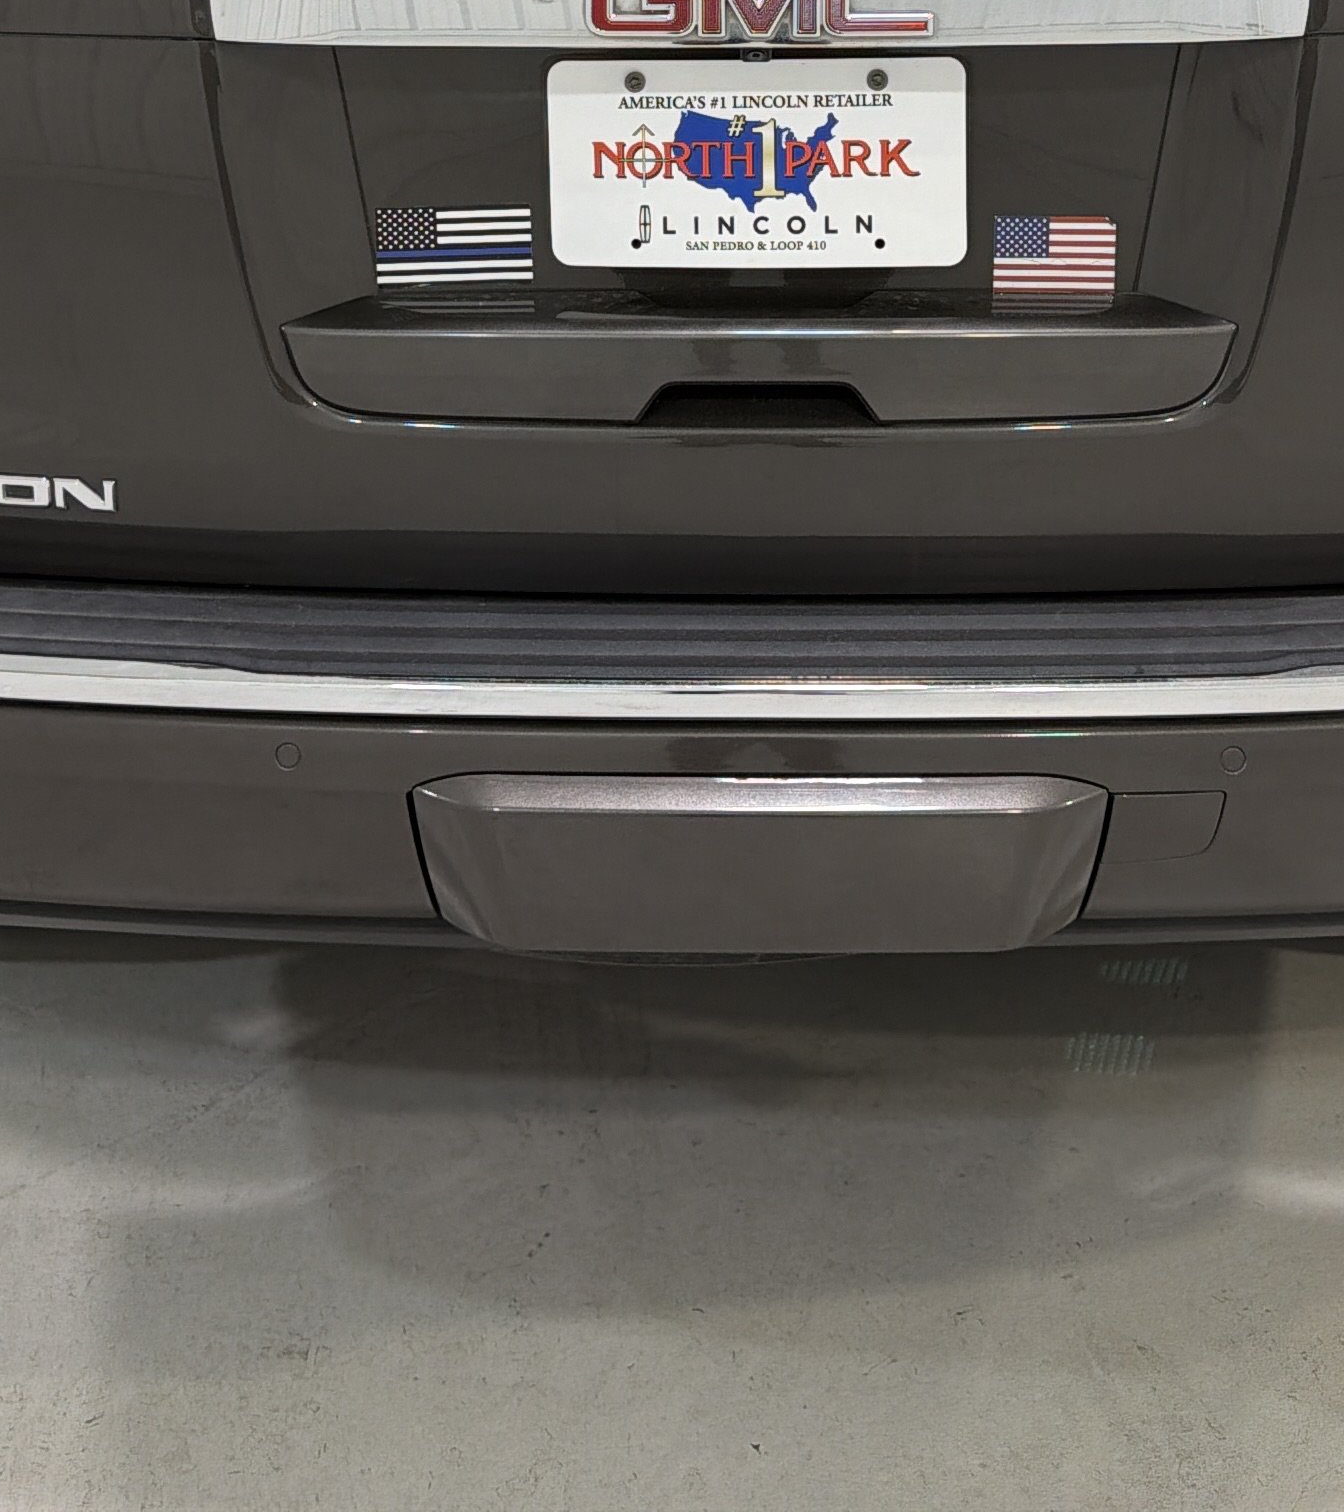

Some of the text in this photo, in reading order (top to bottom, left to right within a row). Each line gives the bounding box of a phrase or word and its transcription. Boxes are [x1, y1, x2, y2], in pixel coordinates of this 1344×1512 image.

[618, 94, 893, 109] AMERICA'S #1 LINCOLN RETAILER
[592, 139, 920, 179] NORTH PARK
[662, 215, 873, 235] LINCOLN
[685, 241, 827, 251] SAN PEDRO & LOOP 410
